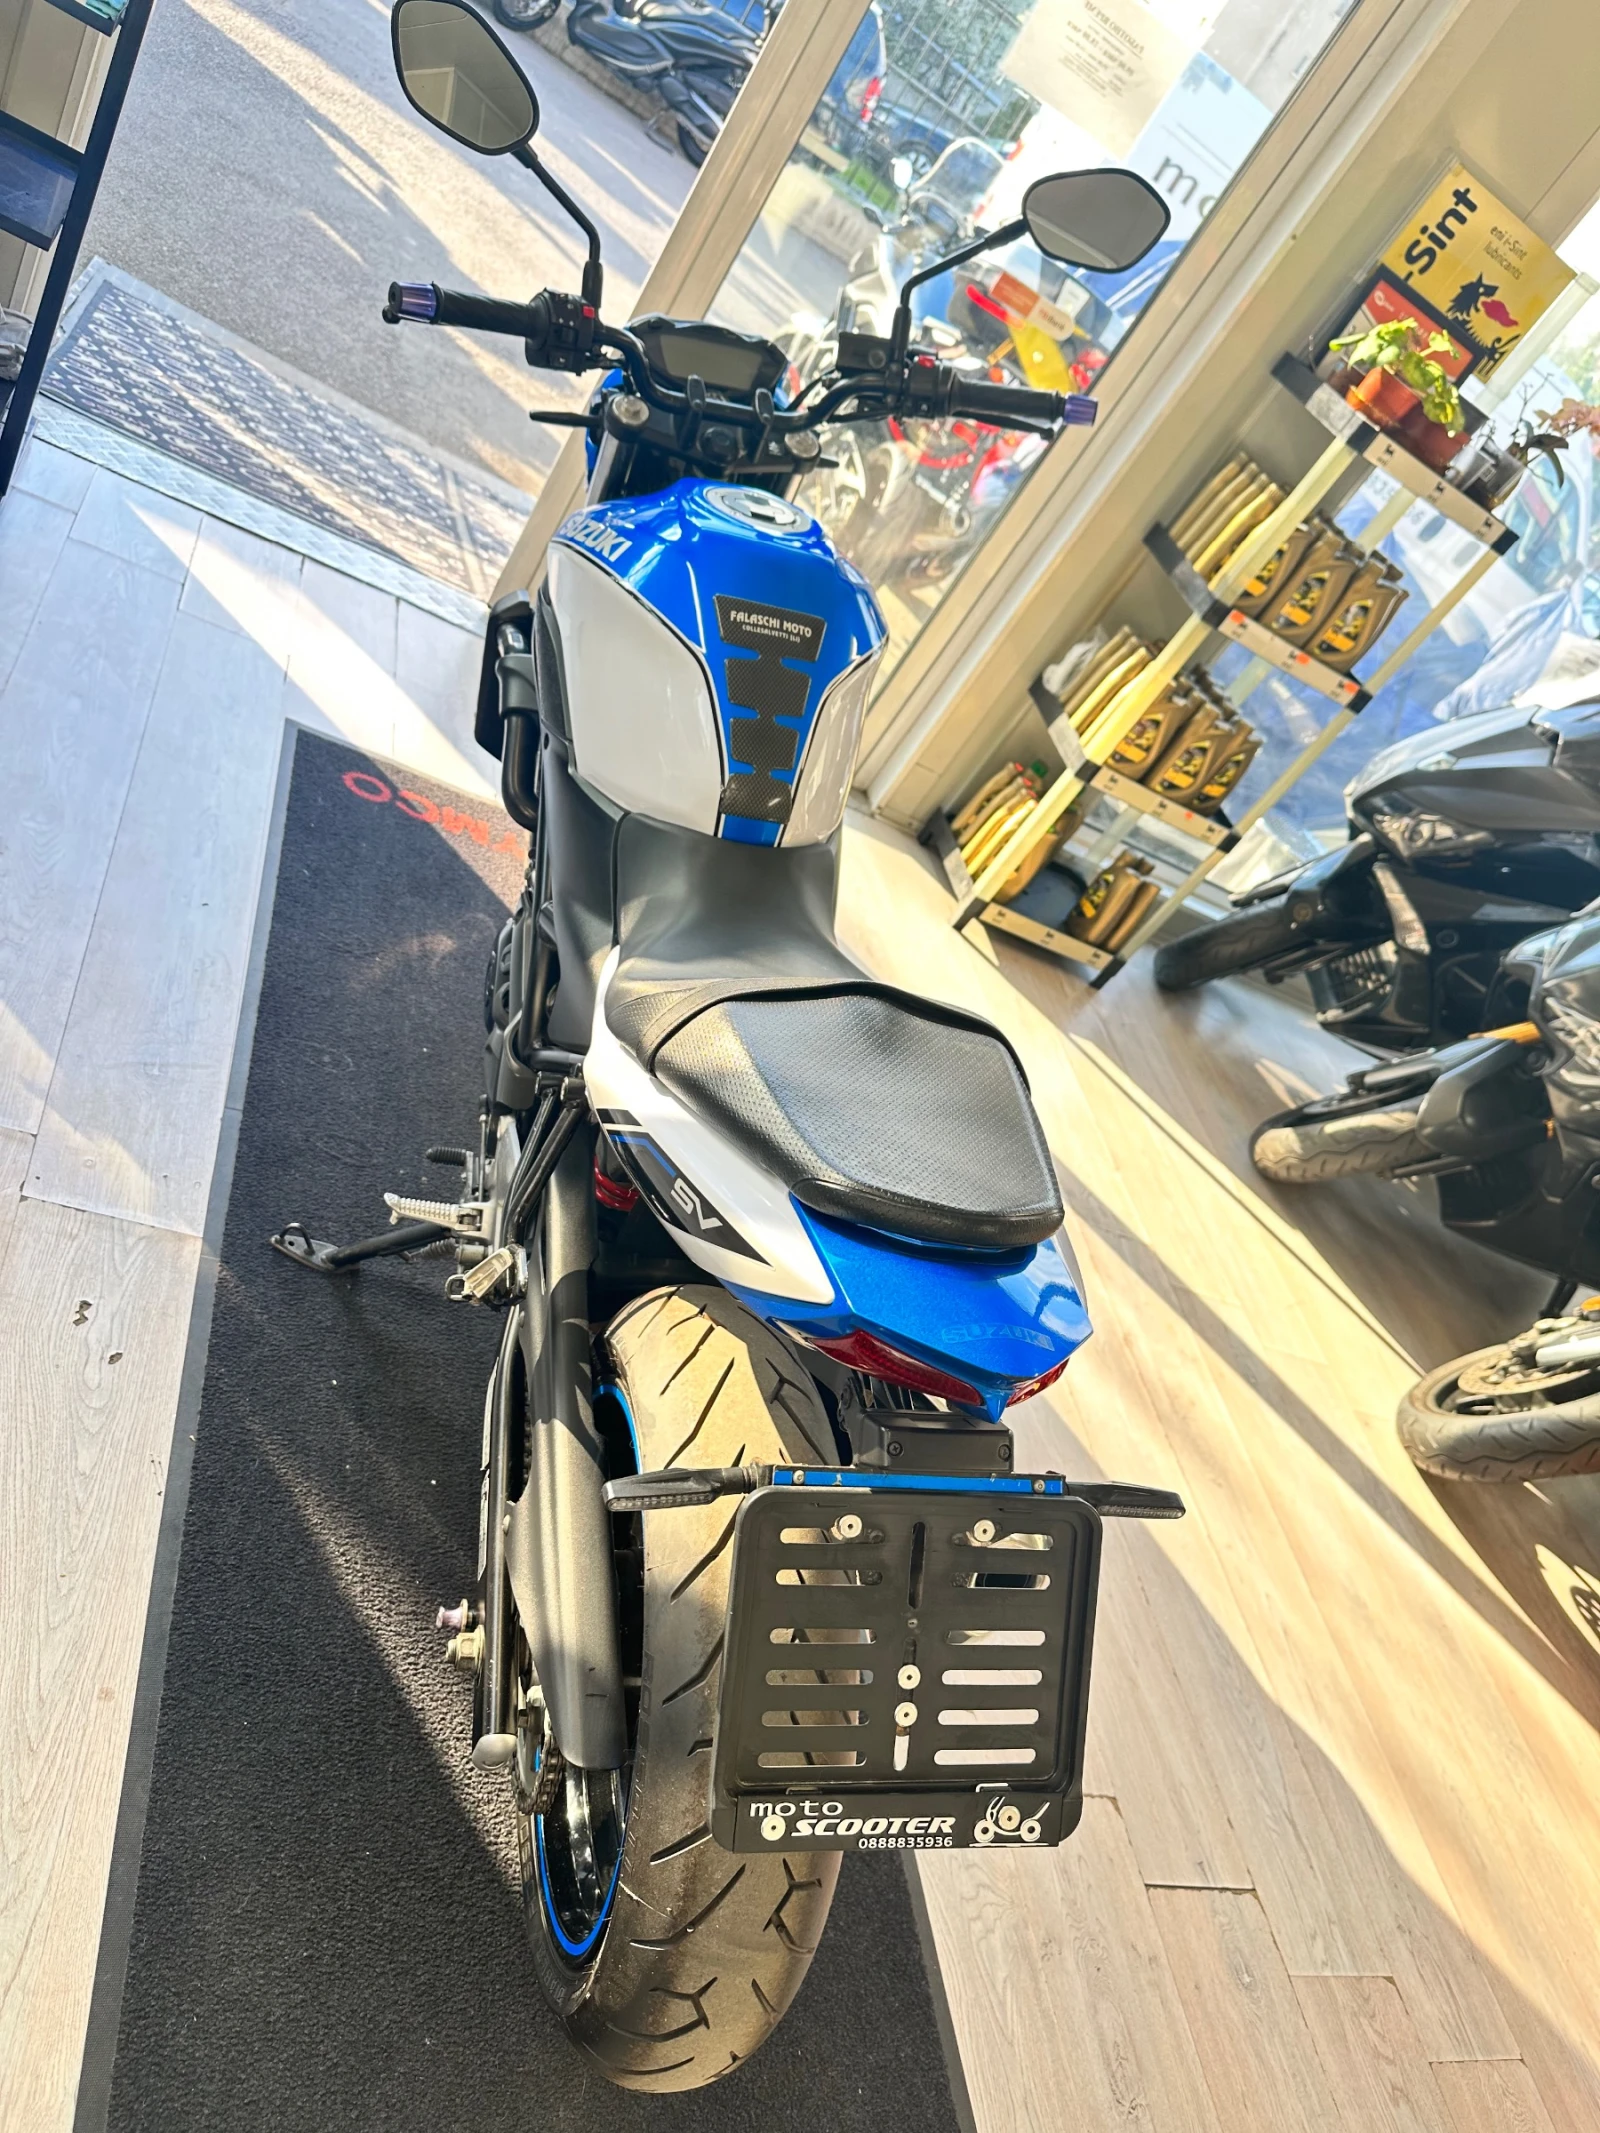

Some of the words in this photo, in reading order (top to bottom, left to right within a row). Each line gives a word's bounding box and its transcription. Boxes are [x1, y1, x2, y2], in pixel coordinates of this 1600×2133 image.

[1403, 187, 1478, 283] -Sint
[1483, 241, 1523, 281] lubricants
[560, 516, 633, 563] SUZUKI
[730, 610, 780, 629] FALASCHI
[783, 620, 812, 637] MOTO
[742, 624, 788, 639] COLLESALVETTI
[343, 771, 525, 861] YMCO
[671, 1178, 723, 1230] SV
[941, 1323, 1055, 1352] SUZUKI
[750, 1799, 843, 1817] moto
[791, 1816, 956, 1837] SCOOTER
[858, 1836, 953, 1849] 0888835936
